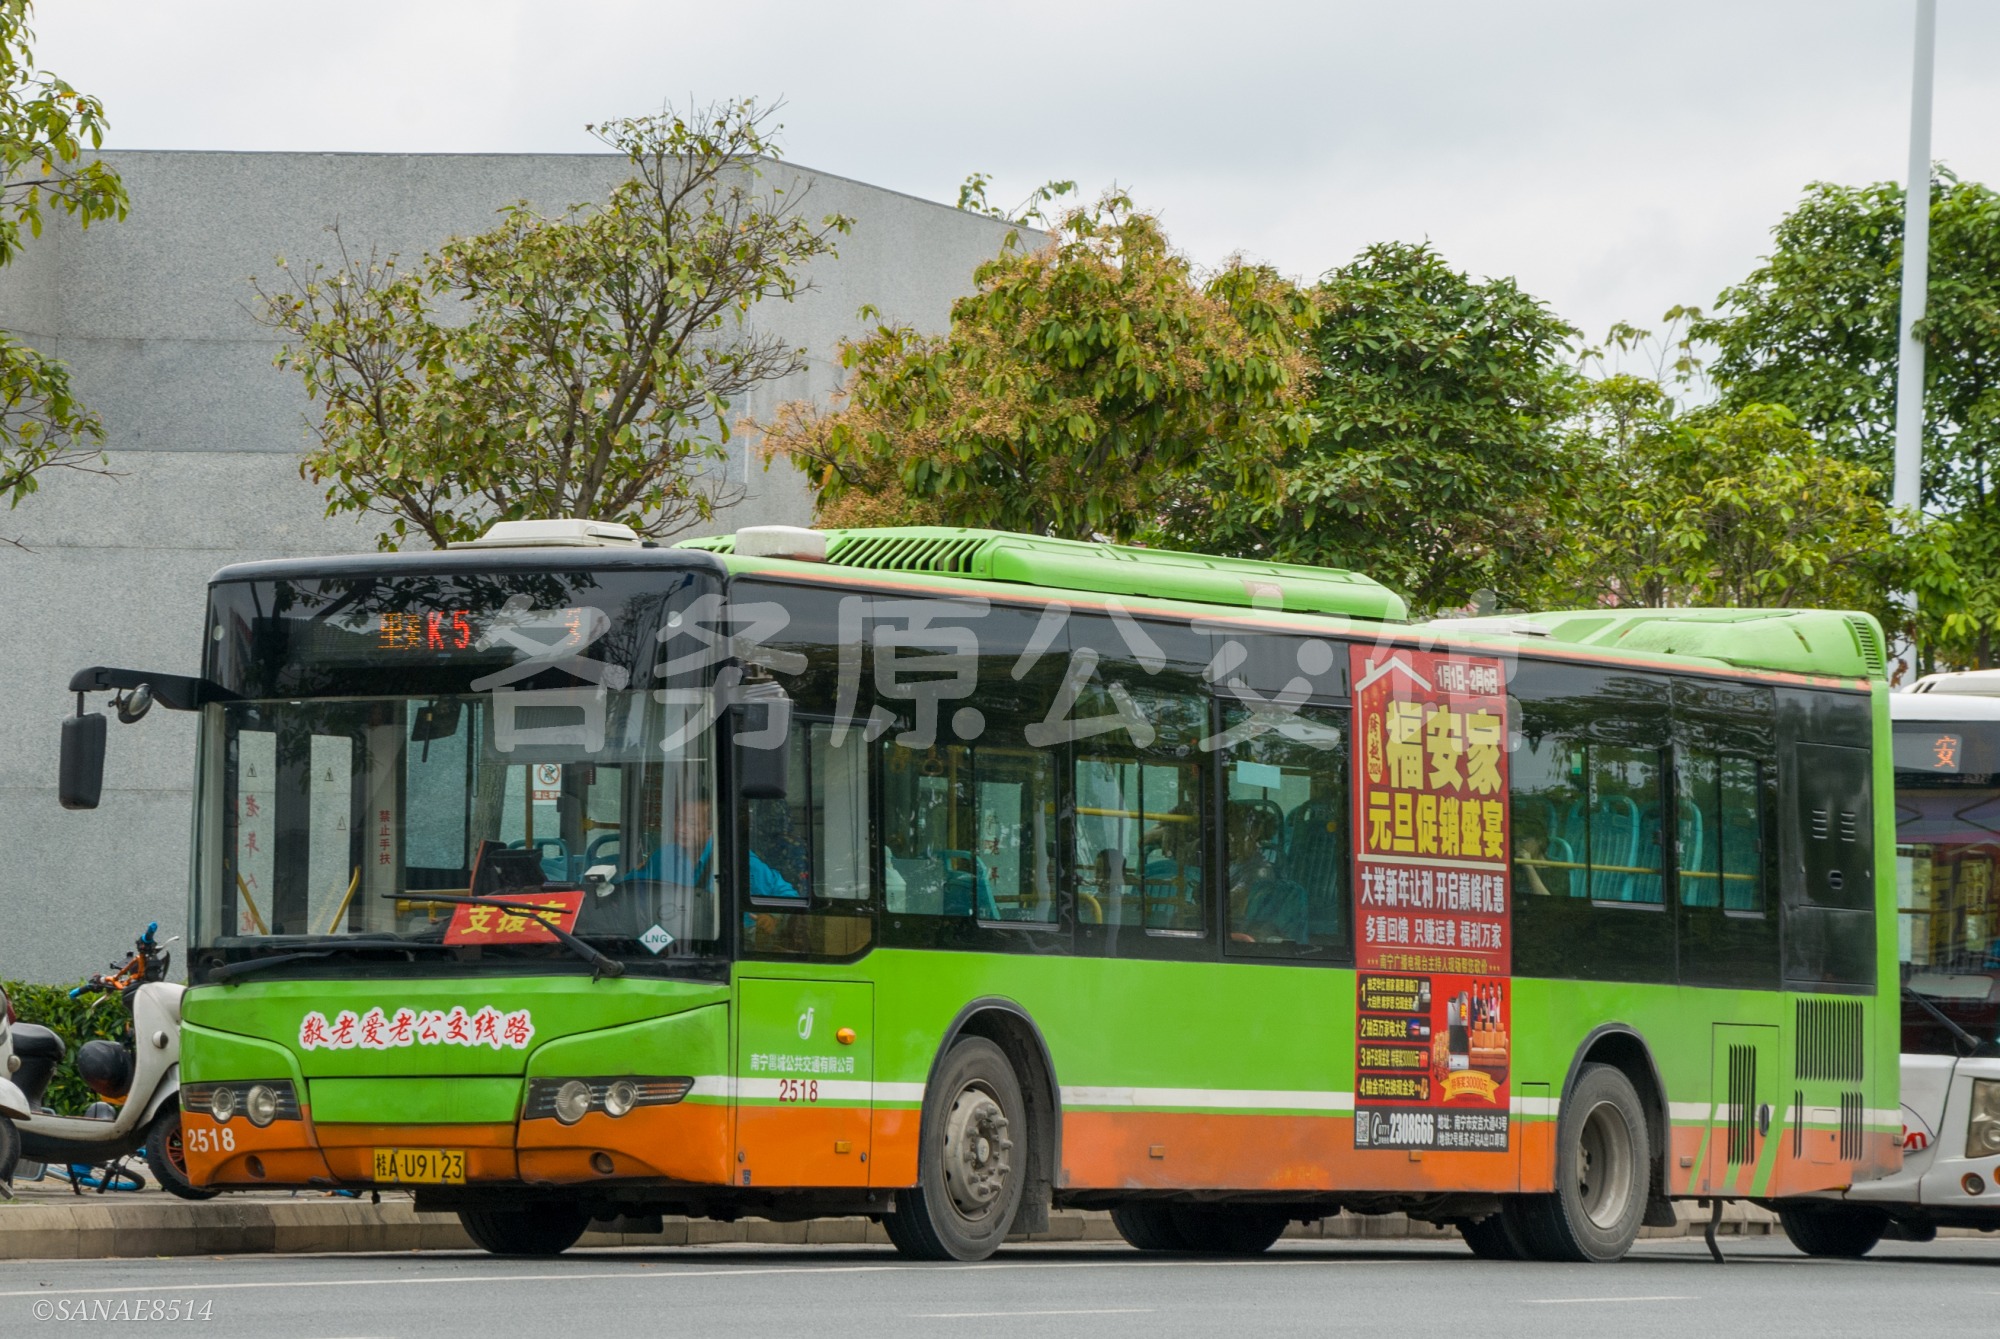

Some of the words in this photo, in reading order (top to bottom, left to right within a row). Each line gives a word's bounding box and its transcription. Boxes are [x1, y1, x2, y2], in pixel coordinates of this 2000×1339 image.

[1436, 664, 1499, 695] 1月1日-2月6日
[1385, 699, 1503, 796] 福安家
[1933, 735, 1957, 768] 安
[379, 809, 391, 865] 禁止手扶
[1368, 790, 1504, 859] 元旦促销盛宴
[1361, 865, 1433, 908] 大举新年让利
[1436, 872, 1505, 913] 开启巅峰优惠
[644, 934, 668, 944] LNG
[1365, 915, 1409, 943] 多重回馈
[1414, 919, 1456, 946] 只赚运费
[1460, 920, 1502, 949] 福利万家
[302, 1007, 532, 1046] 敬老爱老公交线路
[750, 1053, 855, 1074] 南宁邕城公共交通有限公司
[779, 1078, 818, 1103] 2518
[187, 1127, 235, 1153] 2518
[1390, 1112, 1434, 1145] 2308666
